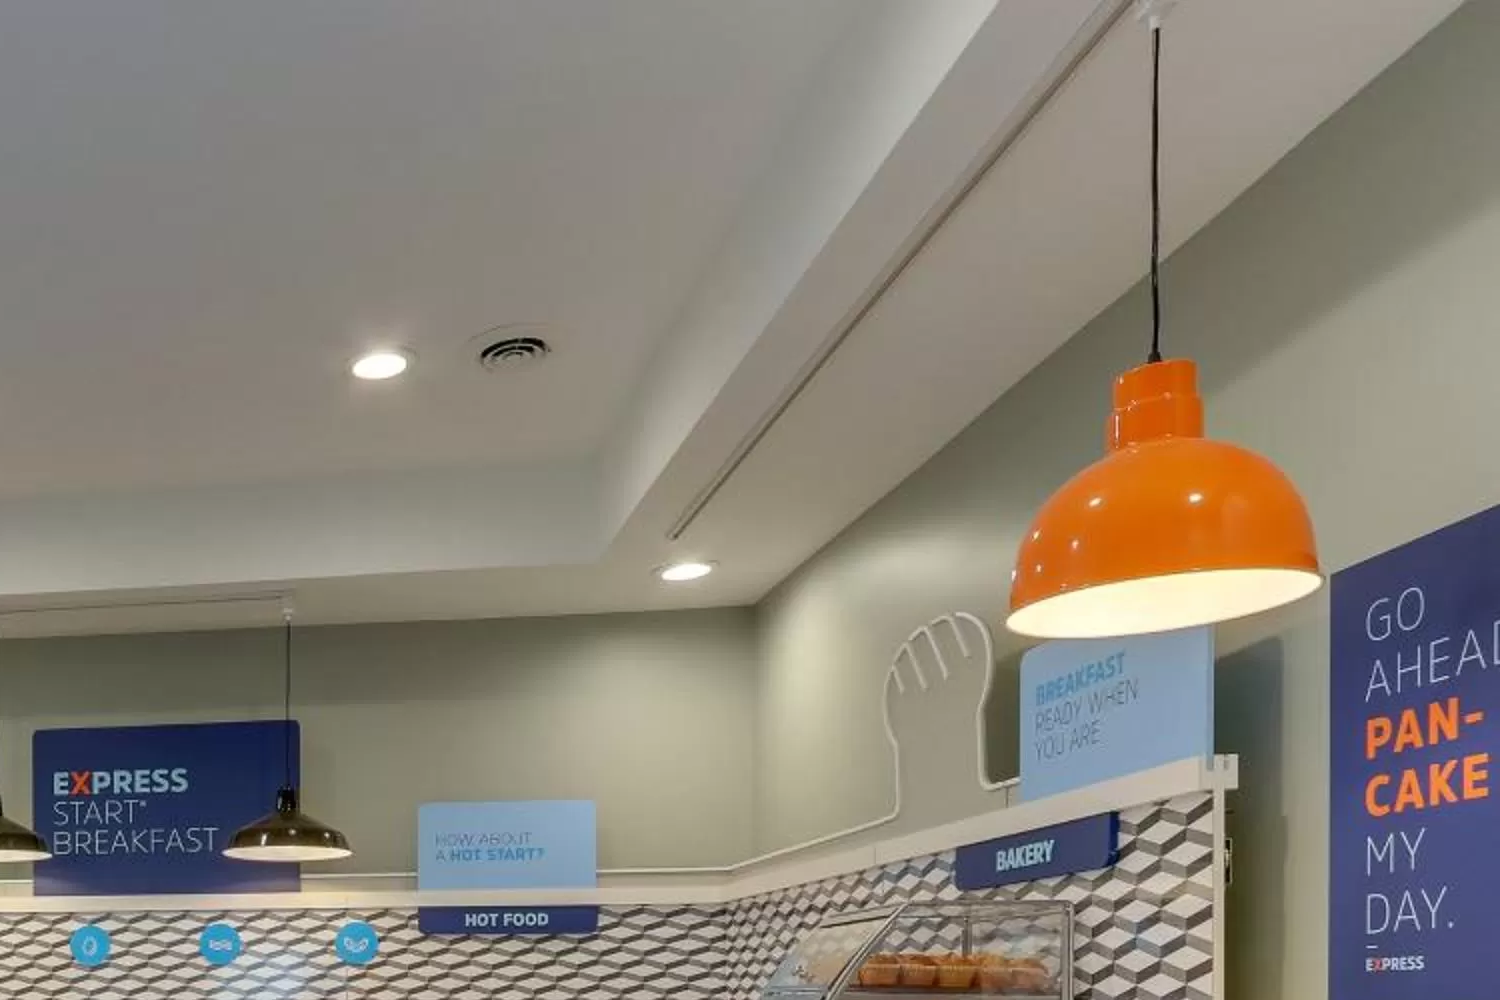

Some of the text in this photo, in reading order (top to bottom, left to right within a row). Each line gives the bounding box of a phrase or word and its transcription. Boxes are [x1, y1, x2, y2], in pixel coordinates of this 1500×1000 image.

[1365, 587, 1425, 641] GO
[1035, 652, 1127, 706] BREAKFAST
[1034, 676, 1140, 736] READY WHEN
[1034, 720, 1102, 761] YOU ARE
[1365, 697, 1484, 760] PAN-
[53, 768, 189, 796] EXPRESS
[1365, 753, 1489, 817] CAKE
[53, 827, 220, 855] BREAKFAST
[435, 831, 533, 848] HOW ABOUT
[436, 847, 546, 862] A HOT START?
[996, 840, 1055, 872] BAKERY
[1367, 827, 1425, 876] MY
[465, 913, 549, 927] HOT FOOD
[1367, 886, 1454, 934] DAY.
[1365, 956, 1425, 971] EXPRESS
